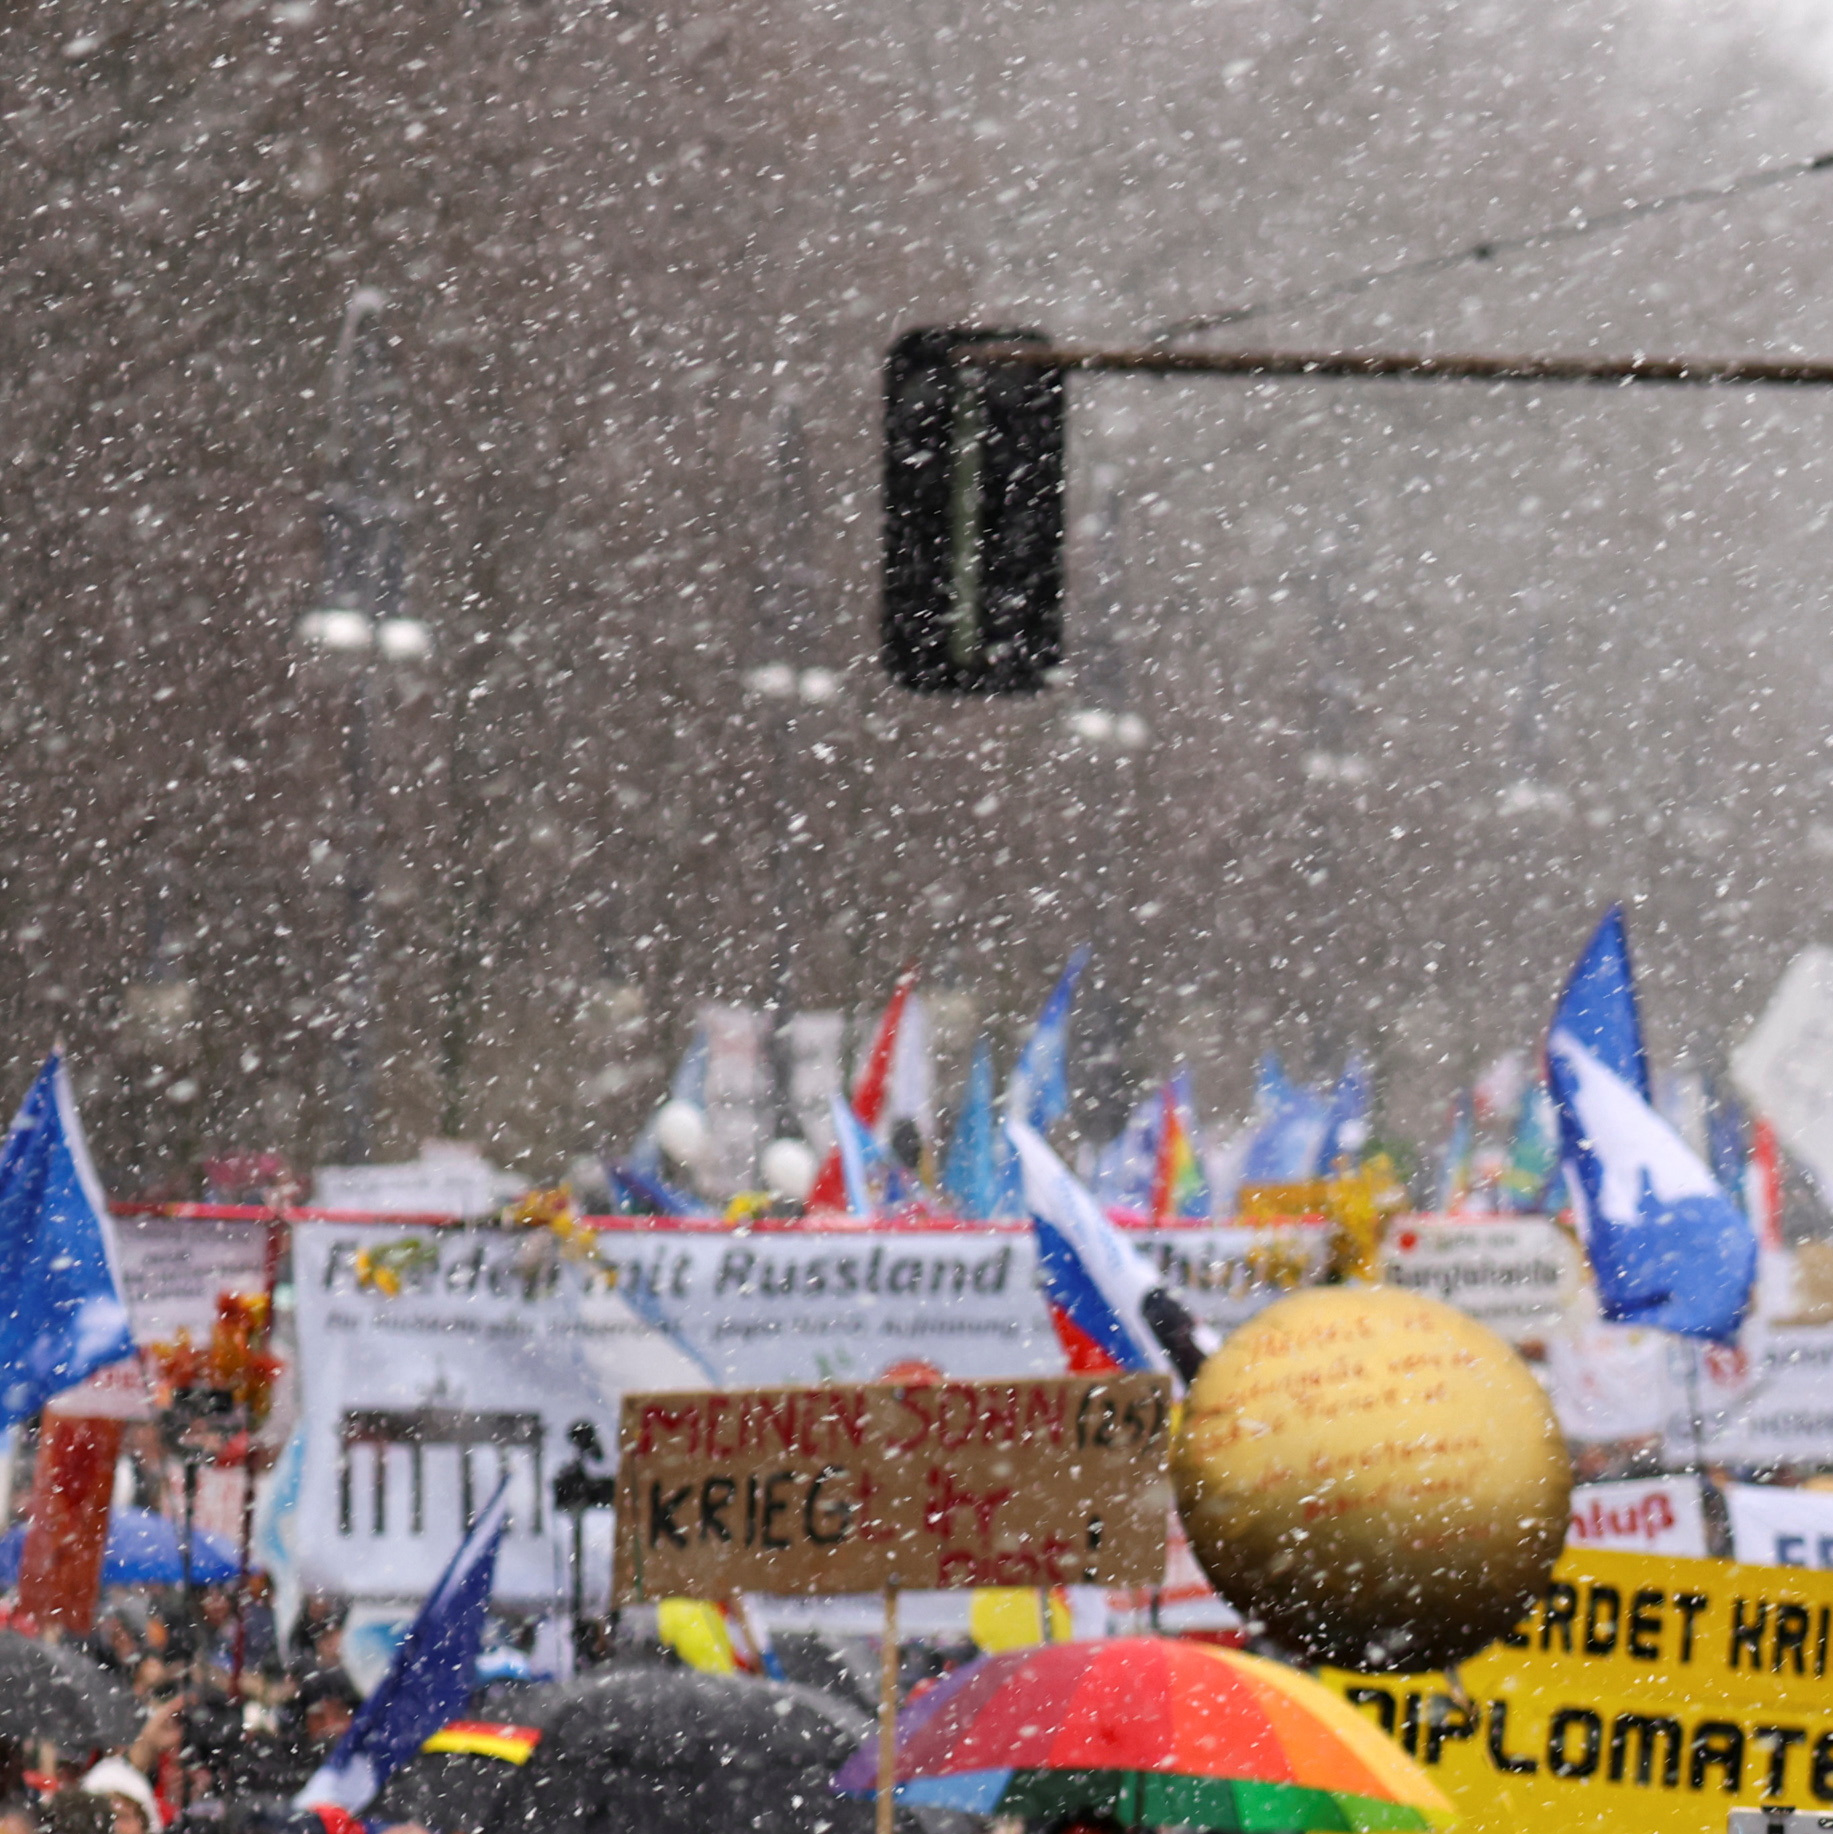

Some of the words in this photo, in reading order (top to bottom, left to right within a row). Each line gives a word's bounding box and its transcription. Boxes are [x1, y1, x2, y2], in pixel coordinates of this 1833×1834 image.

[714, 1244, 1011, 1297] Russland
[637, 1390, 866, 1459] MEINEN
[886, 1382, 1066, 1453] SOHN
